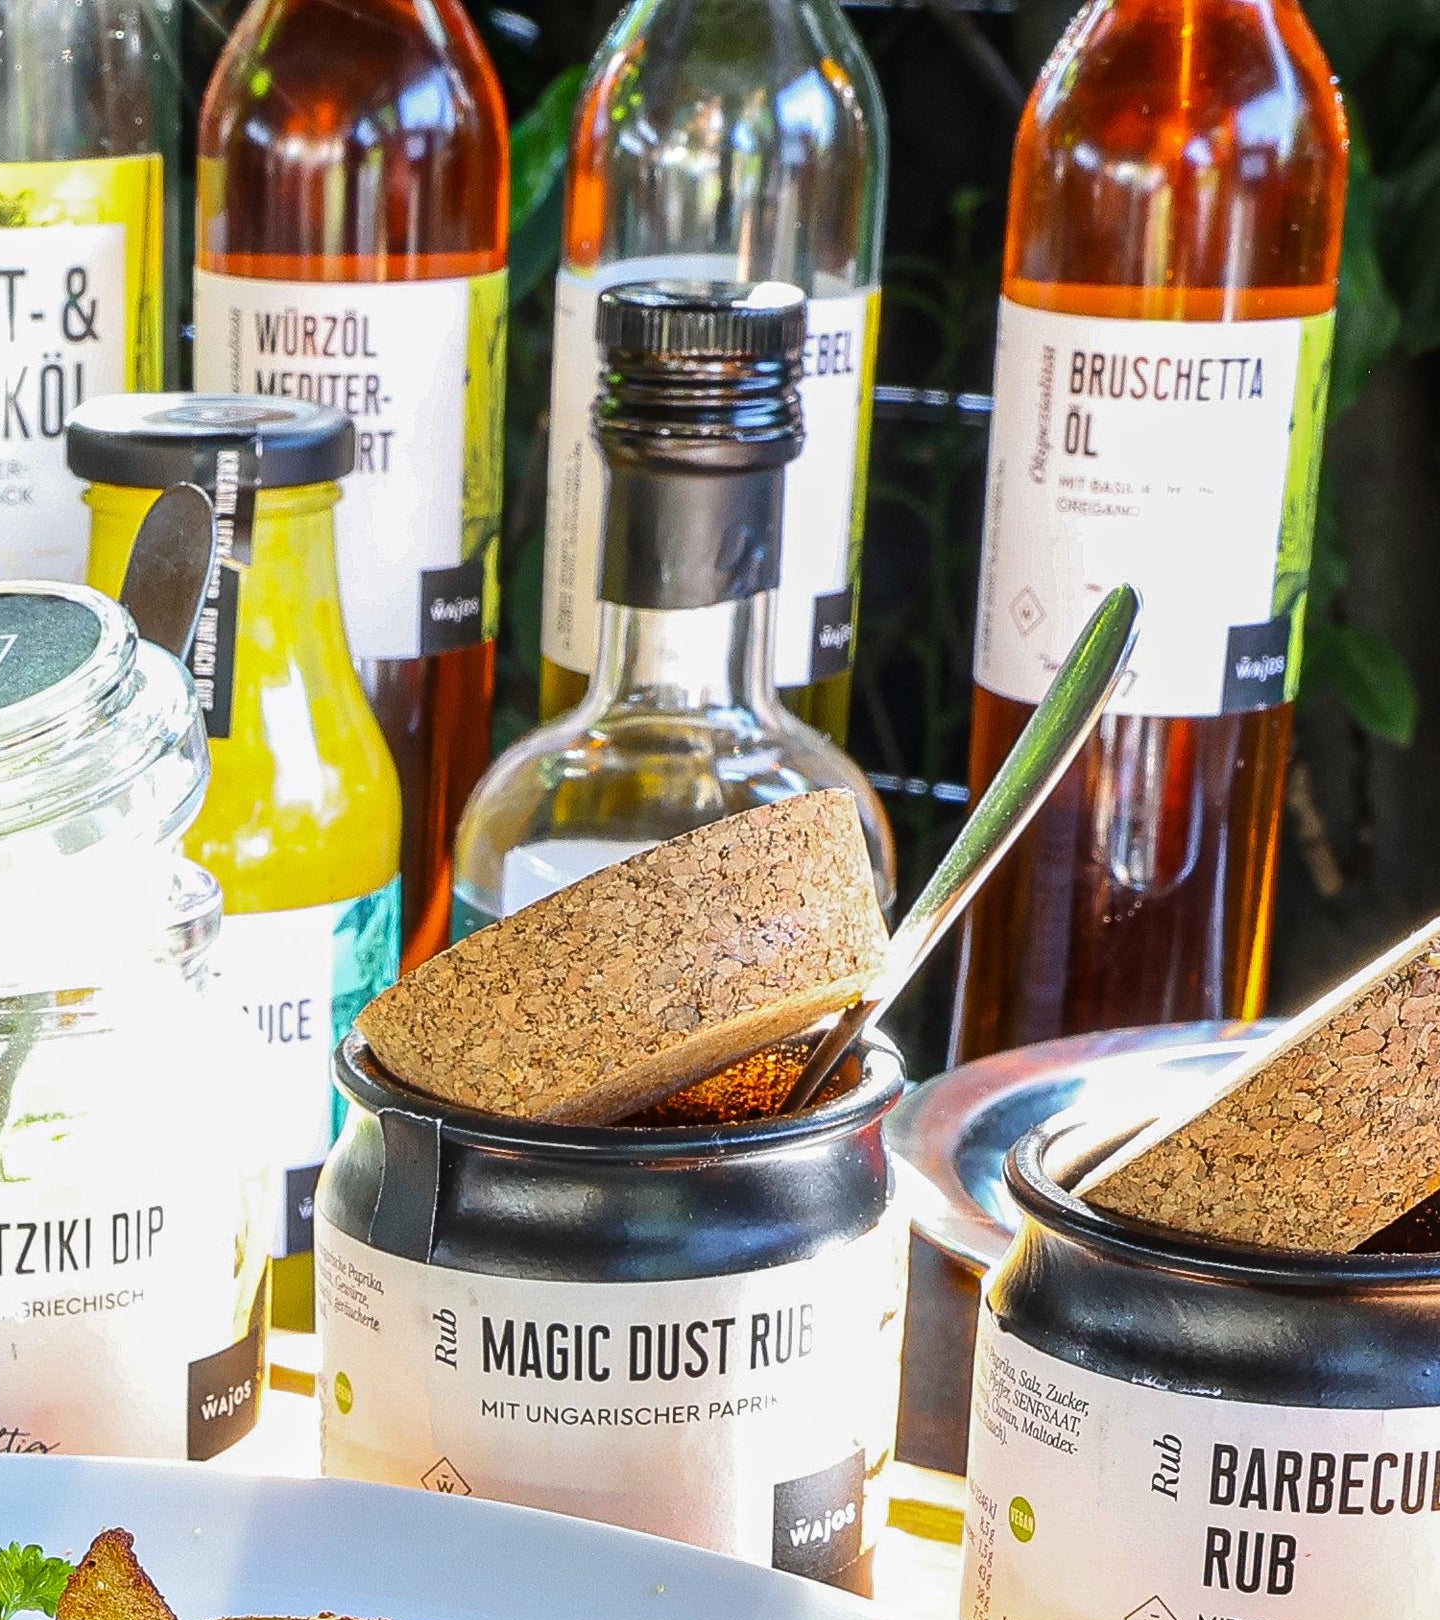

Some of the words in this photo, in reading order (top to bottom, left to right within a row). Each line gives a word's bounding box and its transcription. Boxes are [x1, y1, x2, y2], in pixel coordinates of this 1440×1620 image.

[63, 266, 99, 345] &
[255, 307, 378, 357] WÜRZÖL
[1070, 351, 1263, 402] BRUSCHETTA
[1064, 403, 1098, 458] ÖL
[112, 1205, 164, 1266] DIP
[432, 1308, 458, 1371] Rub
[482, 1315, 611, 1383] MAGIC
[629, 1316, 736, 1382] DUST
[750, 1303, 814, 1371] RUB
[481, 1399, 520, 1420] MIT
[526, 1403, 700, 1427] UNGARISCHER
[1012, 1389, 1082, 1438] SENFSAAT,
[1019, 1369, 1042, 1399] Salz,
[1046, 1383, 1090, 1417] Zucker,
[1020, 1416, 1079, 1455] Maltodex-
[1150, 1432, 1183, 1503] Rub
[1010, 1505, 1035, 1533] VEGAN
[1202, 1526, 1299, 1596] RUB
